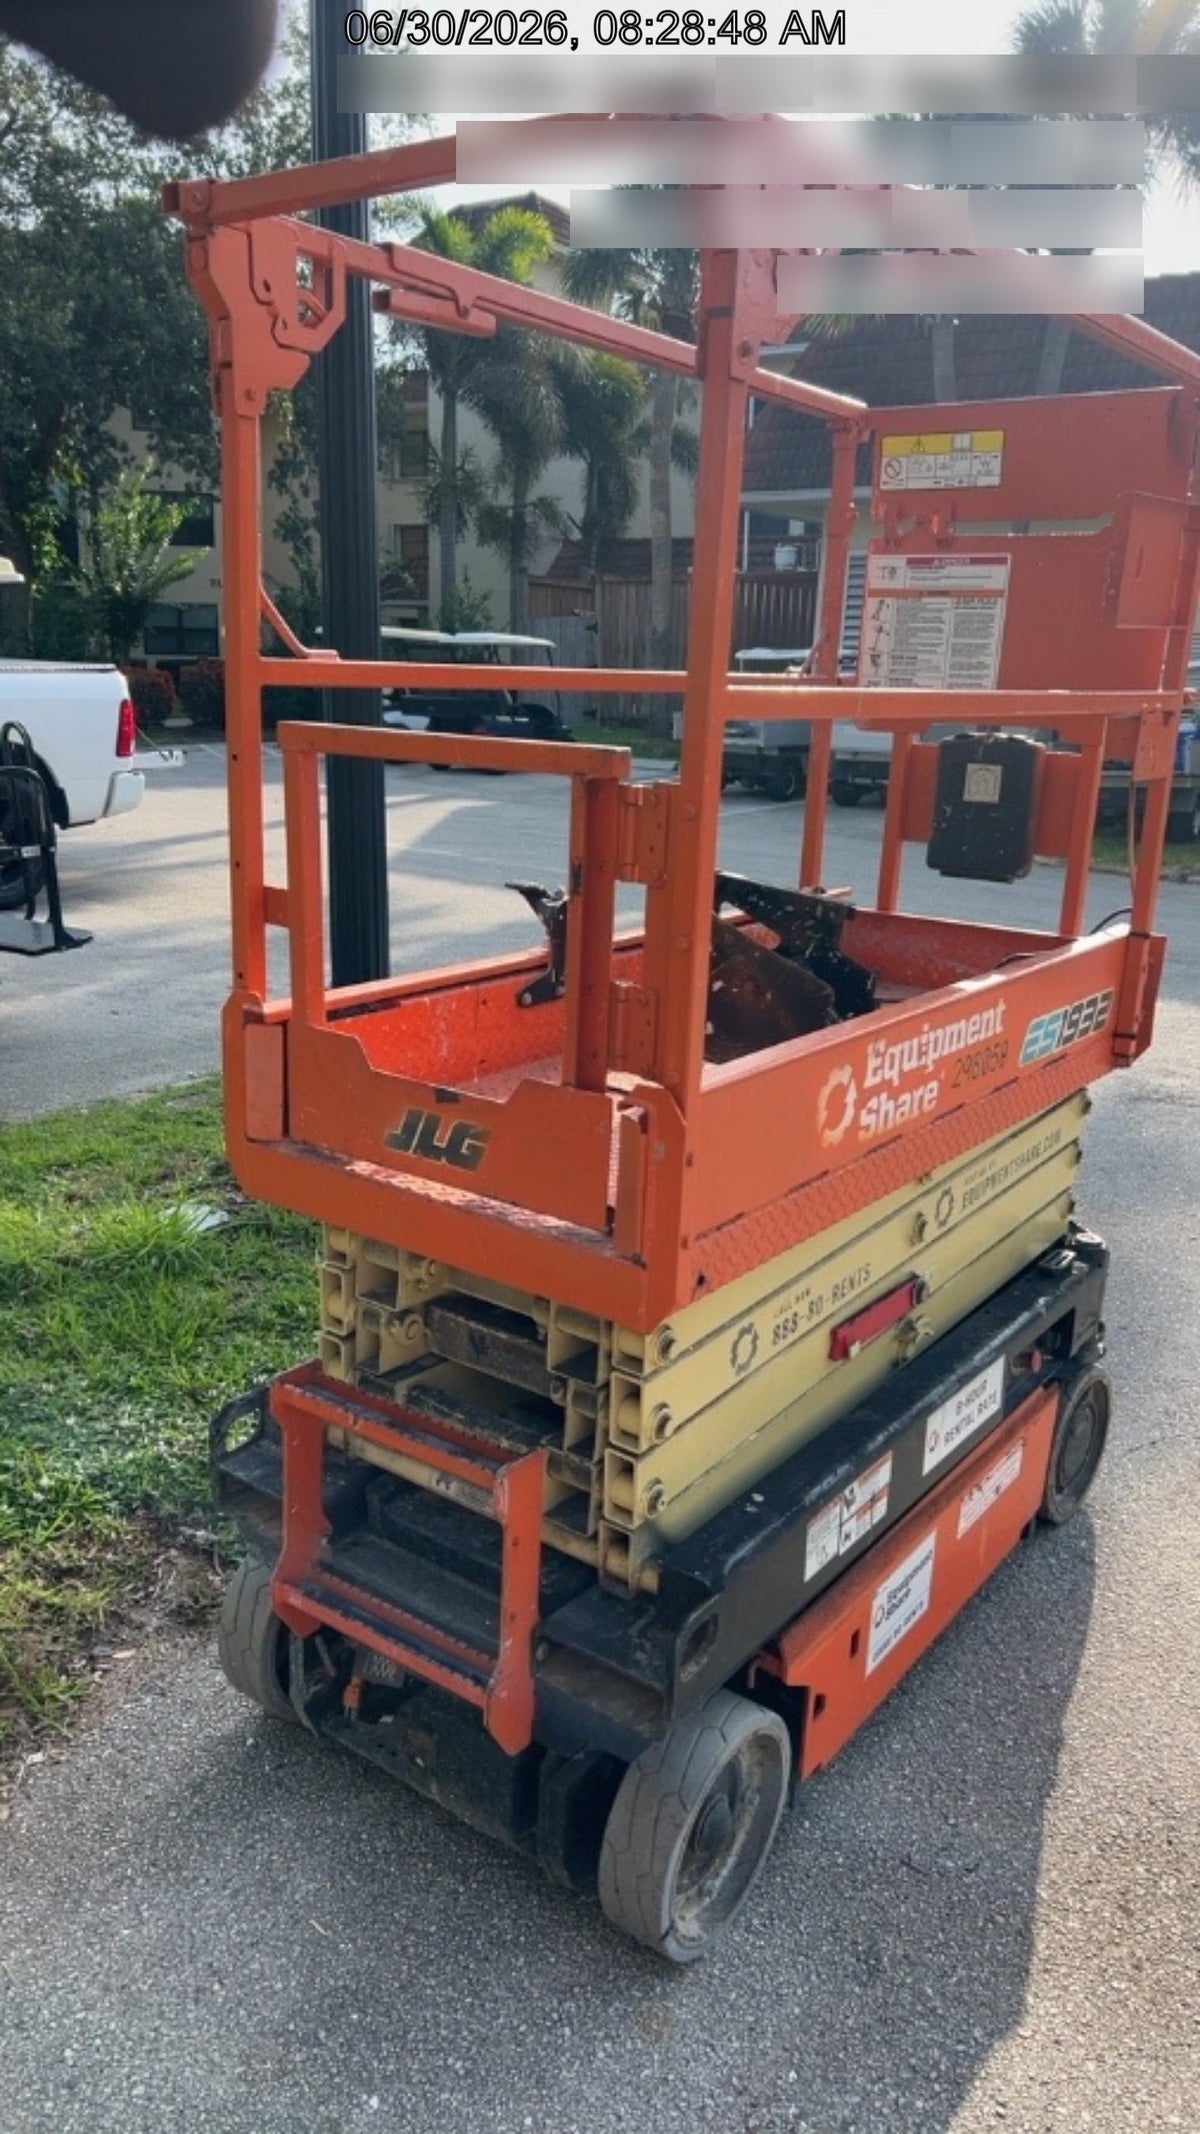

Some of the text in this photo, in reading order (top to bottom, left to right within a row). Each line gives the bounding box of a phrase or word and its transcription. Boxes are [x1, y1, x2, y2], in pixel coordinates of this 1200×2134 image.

[863, 1002, 1006, 1087] Equipment
[383, 1106, 491, 1173] JLG
[859, 1080, 939, 1142] Share
